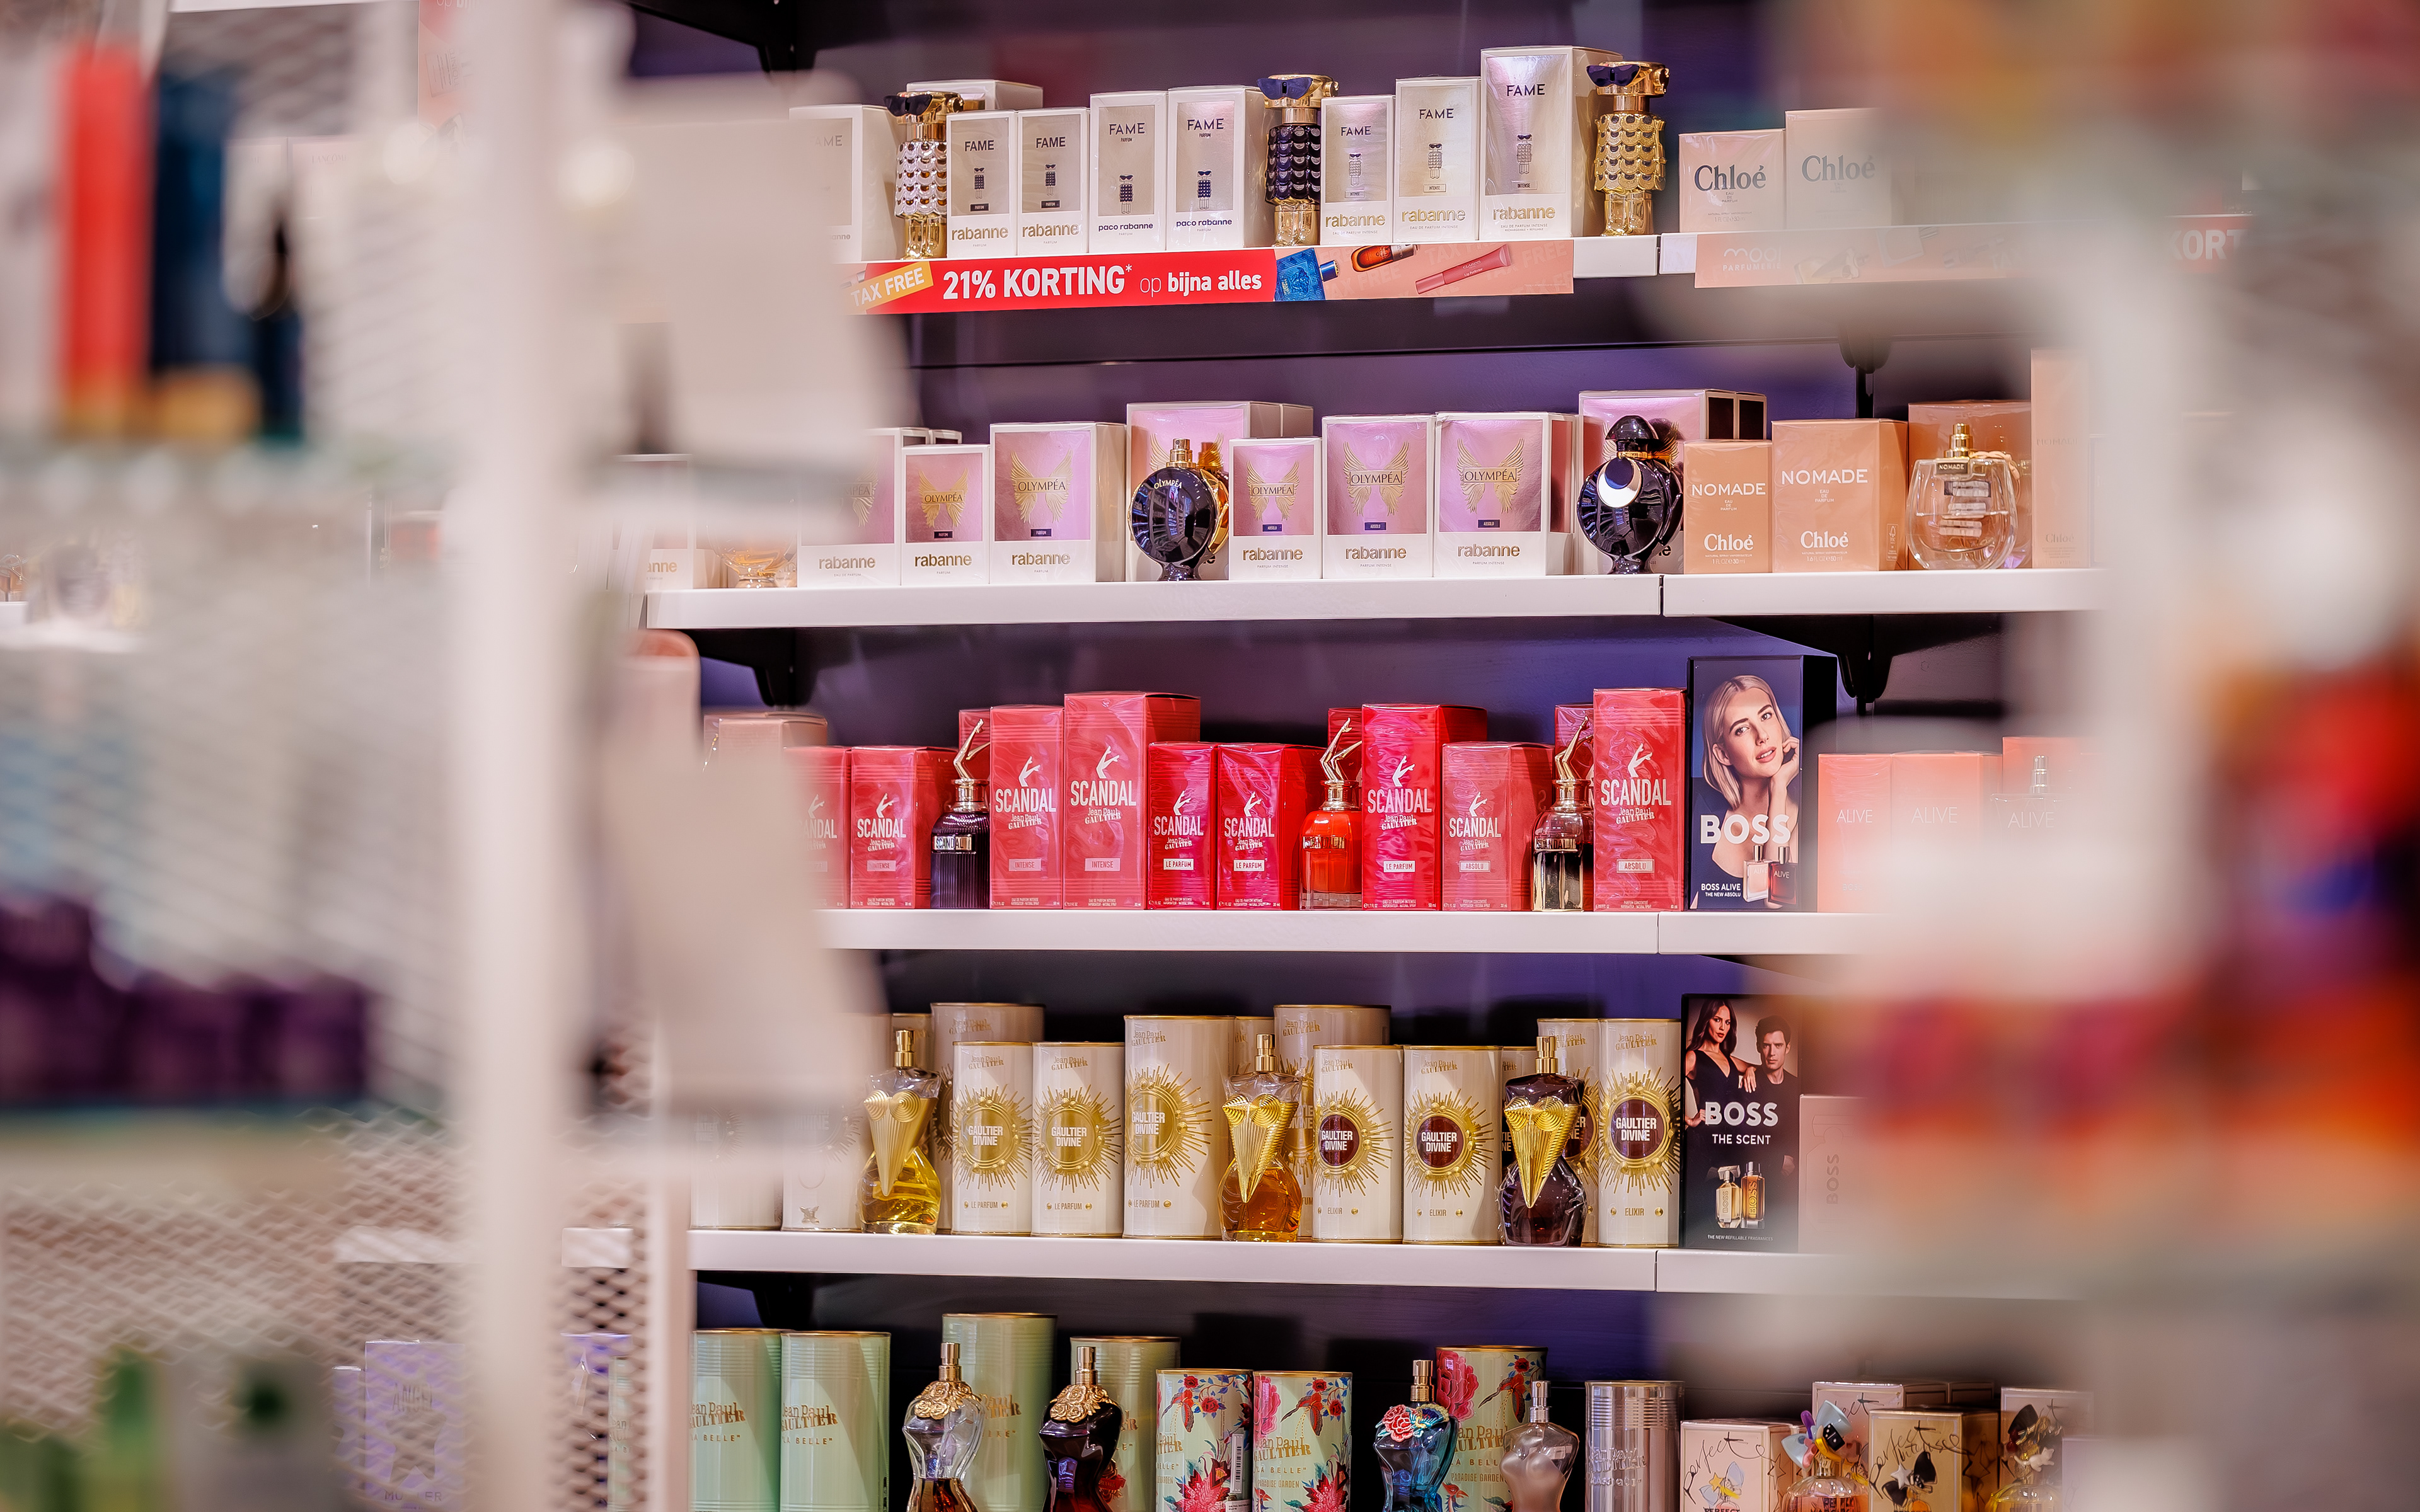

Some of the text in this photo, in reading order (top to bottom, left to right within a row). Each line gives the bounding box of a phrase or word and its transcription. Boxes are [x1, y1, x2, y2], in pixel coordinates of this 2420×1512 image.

[1506, 83, 1545, 96] FAME
[1419, 108, 1455, 120] FAME
[1109, 122, 1146, 135] FAME
[1187, 118, 1224, 130] FAME
[1340, 125, 1371, 136] FAME
[964, 140, 994, 152] FAME
[1035, 136, 1066, 148] FAME
[1802, 154, 1876, 182] Chloé
[1694, 164, 1766, 192] Chloé
[1402, 207, 1466, 222] rabanne
[1492, 206, 1555, 220] rabanne
[1176, 218, 1232, 227] paco rabanne
[1325, 213, 1386, 228] rabanne
[951, 226, 1009, 241] rabanne
[1022, 223, 1080, 238] rabanne
[1098, 224, 1119, 232] paco
[851, 267, 925, 307] TAX FREE
[943, 270, 996, 301] 21%
[1139, 275, 1161, 298] op
[1167, 272, 1212, 297] bijna
[1218, 270, 1262, 291] alles
[1351, 471, 1401, 484] OLYMPÉA
[1464, 469, 1515, 482] OLYMPÉA
[1781, 469, 1868, 485] NOMADE
[1018, 478, 1066, 491] OLYMPÉA
[1252, 484, 1293, 495] OLYMPÉA
[1692, 483, 1766, 496] NOMADE
[924, 492, 963, 503] OLYMPÉA
[1704, 533, 1754, 551] Chloé
[1801, 530, 1849, 549] Chloé
[1243, 547, 1303, 561] rabanne
[1345, 546, 1407, 560] rabanne
[1457, 542, 1520, 558] rabanne
[819, 556, 875, 571] rabanne
[914, 553, 972, 567] rabanne
[1011, 551, 1071, 566] rabanne
[1070, 780, 1137, 806] SCANDAL
[1601, 779, 1672, 806] SCANDAL
[995, 788, 1057, 813] SCANDAL
[1368, 788, 1432, 813] SCANDAL
[1618, 808, 1651, 816] Jean Paul
[1836, 810, 1873, 823] ALIVE
[1911, 807, 1958, 824] ALIVE
[1154, 815, 1204, 836] SCANDAL
[2007, 811, 2054, 828] ALIVE
[857, 818, 907, 839] SCANDAL
[1224, 817, 1275, 838] SCANDAL
[1449, 817, 1502, 837] SCANDAL
[1700, 813, 1791, 844] BOSS
[1624, 862, 1647, 870] ABSOLU
[1773, 870, 1790, 879] ALIVE
[1133, 1031, 1146, 1039] Jean
[1618, 1033, 1654, 1043] Jean Paul
[971, 1055, 1001, 1063] Jean Paul
[1054, 1056, 1068, 1064] Jean
[1423, 1060, 1438, 1068] Jean
[1131, 1112, 1165, 1124] GAULTIER
[1705, 1101, 1778, 1126] BOSS
[1135, 1124, 1159, 1135] DIVINE
[1616, 1117, 1657, 1130] GAULTIER
[968, 1126, 1003, 1136] GAULTIER
[1051, 1126, 1087, 1137] GAULTIER
[1322, 1130, 1353, 1141] GAULTIER
[1421, 1131, 1457, 1143] GAULTIER
[1621, 1130, 1651, 1142] DIVINE
[972, 1136, 998, 1146] DIVINE
[1056, 1137, 1081, 1147] DIVINE
[1325, 1141, 1347, 1151] DIVINE
[1712, 1134, 1771, 1145] THE SCENT
[1426, 1142, 1451, 1152] DIVINE
[1826, 1154, 1840, 1205] BOSS
[1139, 1200, 1160, 1208] PARFUM
[1748, 1180, 1757, 1215] BOSS
[1625, 1208, 1645, 1216] ELIXIR
[801, 1404, 831, 1418] Paul
[1253, 1444, 1312, 1462] GAULTIER
[1451, 1472, 1478, 1482] PARADISE
